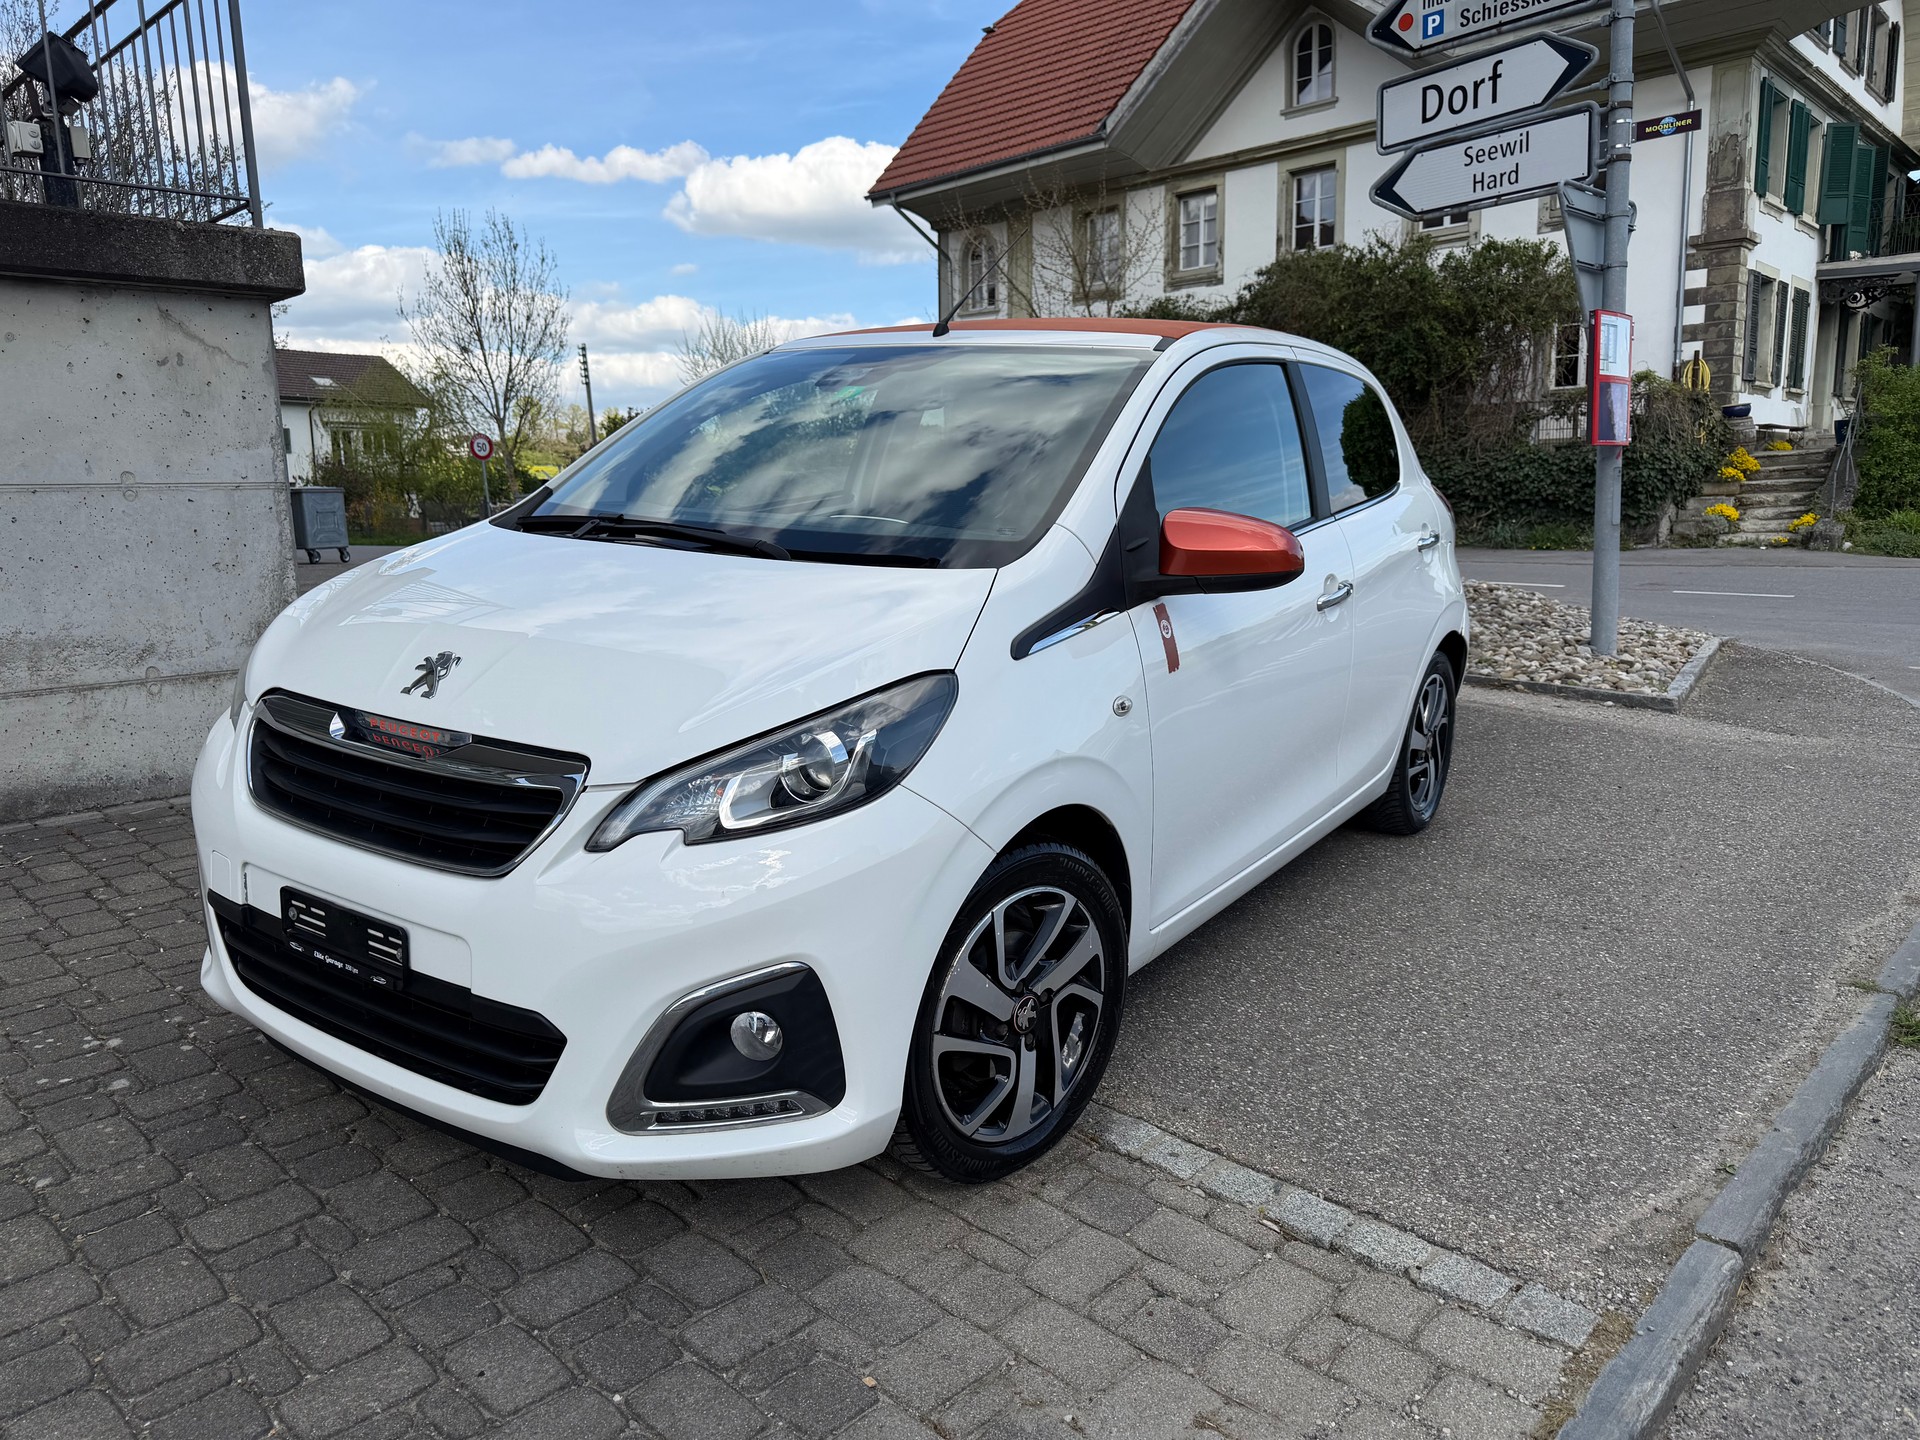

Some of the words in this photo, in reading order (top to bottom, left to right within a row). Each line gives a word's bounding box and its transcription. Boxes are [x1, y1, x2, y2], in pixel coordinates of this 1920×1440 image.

[1460, 0, 1550, 28] Schiess
[1421, 59, 1503, 124] Dorf
[1645, 118, 1692, 133] MOONLINER
[1464, 130, 1529, 167] Seewil
[1473, 162, 1519, 193] Hard
[476, 442, 487, 452] 50
[369, 717, 441, 743] PEUGEOT
